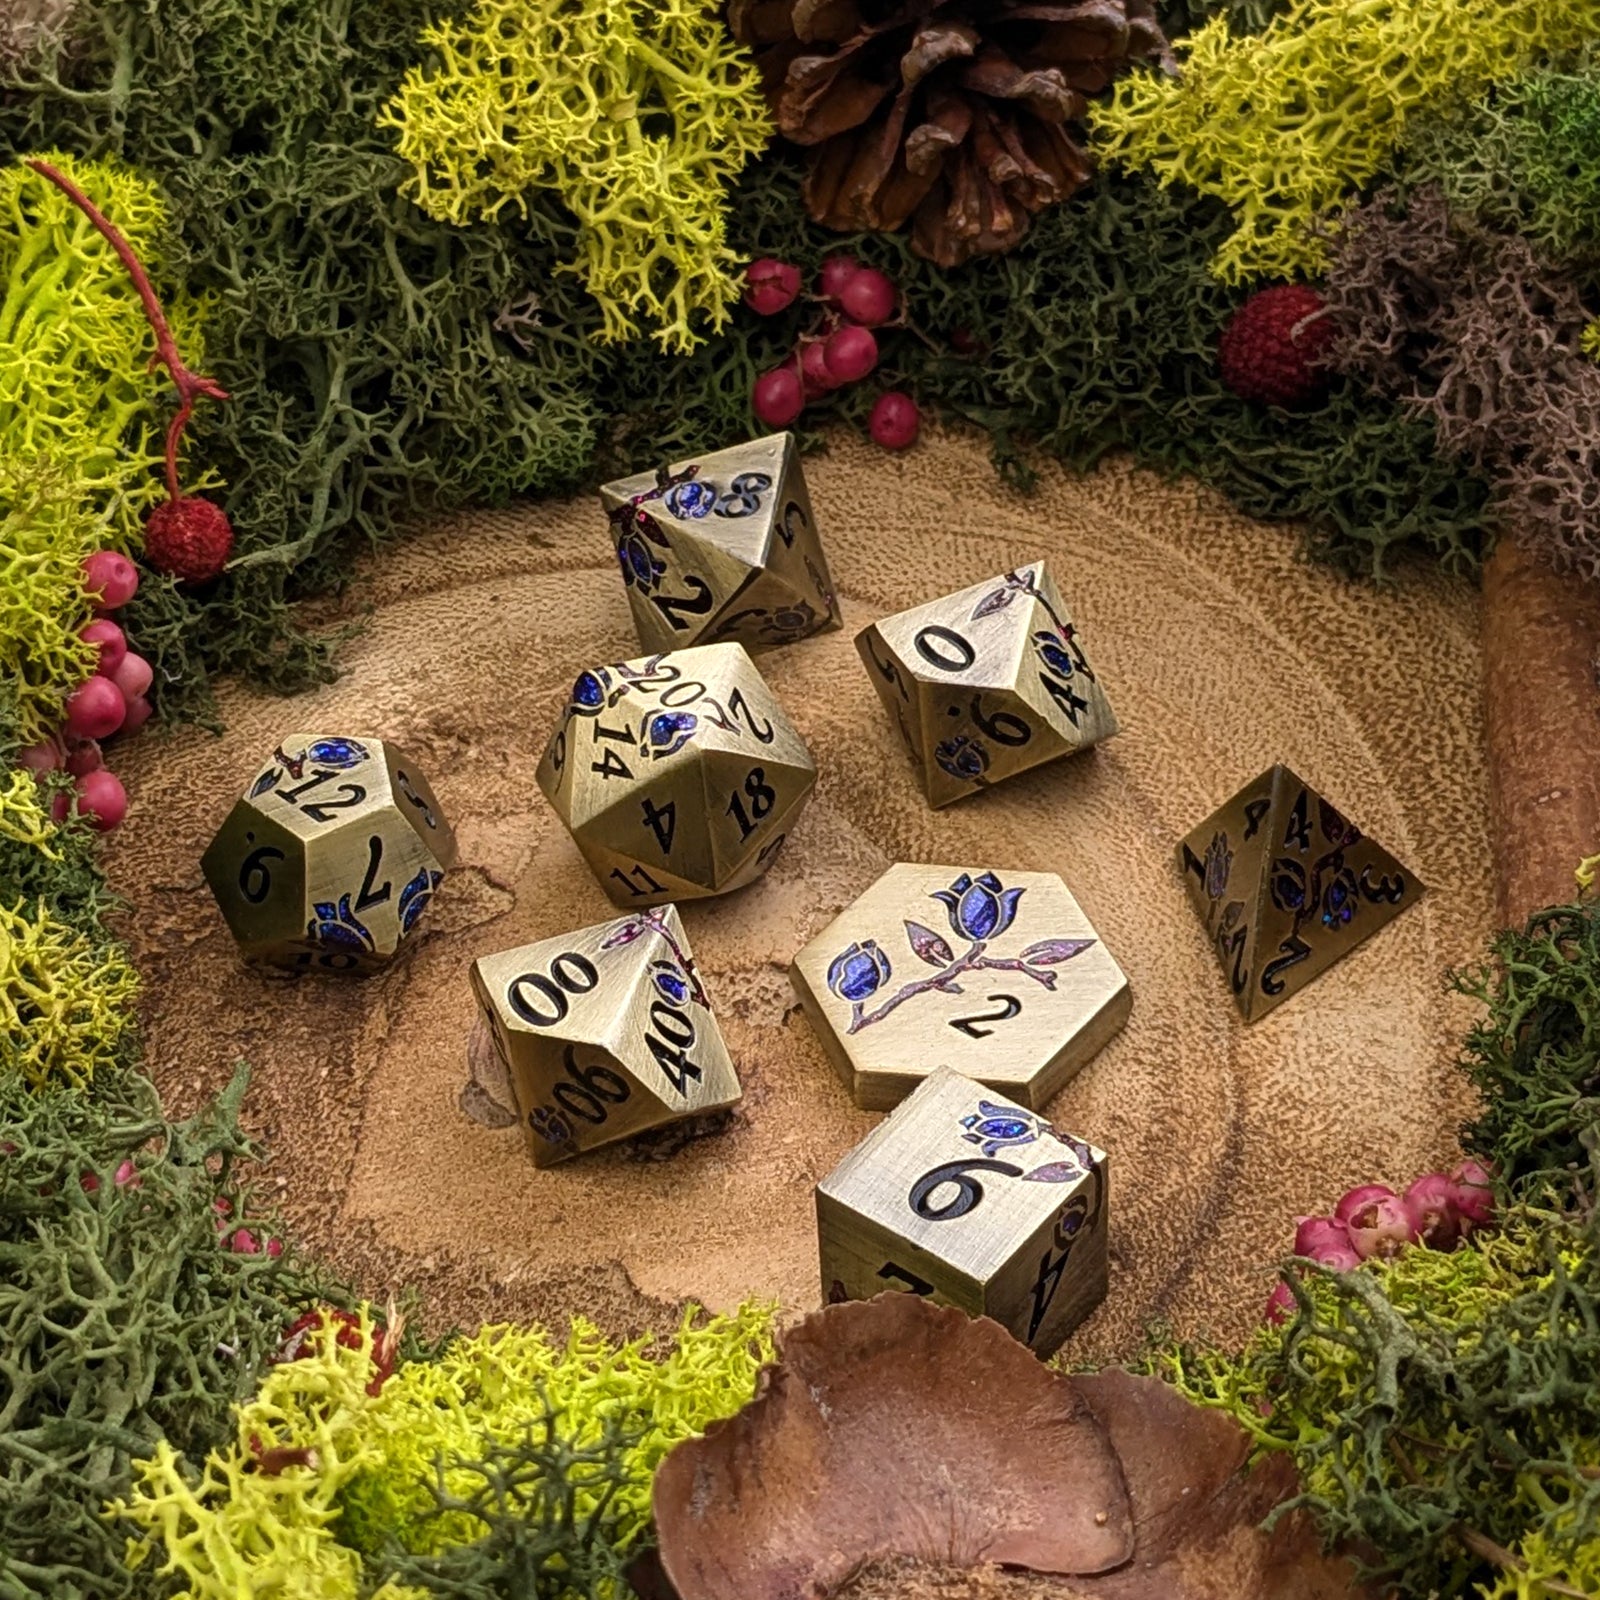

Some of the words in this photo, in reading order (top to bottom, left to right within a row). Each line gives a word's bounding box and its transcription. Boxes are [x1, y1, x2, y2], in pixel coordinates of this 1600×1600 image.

[713, 472, 772, 518] 8
[651, 575, 713, 631] 2
[914, 625, 976, 672] 0
[627, 664, 707, 708] 20
[1039, 671, 1088, 730] 4
[728, 687, 774, 744] 2
[592, 717, 637, 780] 14
[274, 769, 367, 822] 12
[725, 767, 776, 843] 18
[1283, 790, 1313, 852] 4
[641, 798, 677, 855] 4
[354, 835, 391, 913] 7
[610, 865, 669, 896] 11
[1359, 863, 1405, 905] 3
[507, 951, 599, 1027] 00
[1260, 935, 1312, 996] 2
[948, 994, 1022, 1039] 2
[644, 1000, 702, 1099] 40
[908, 1158, 1024, 1221] 6
